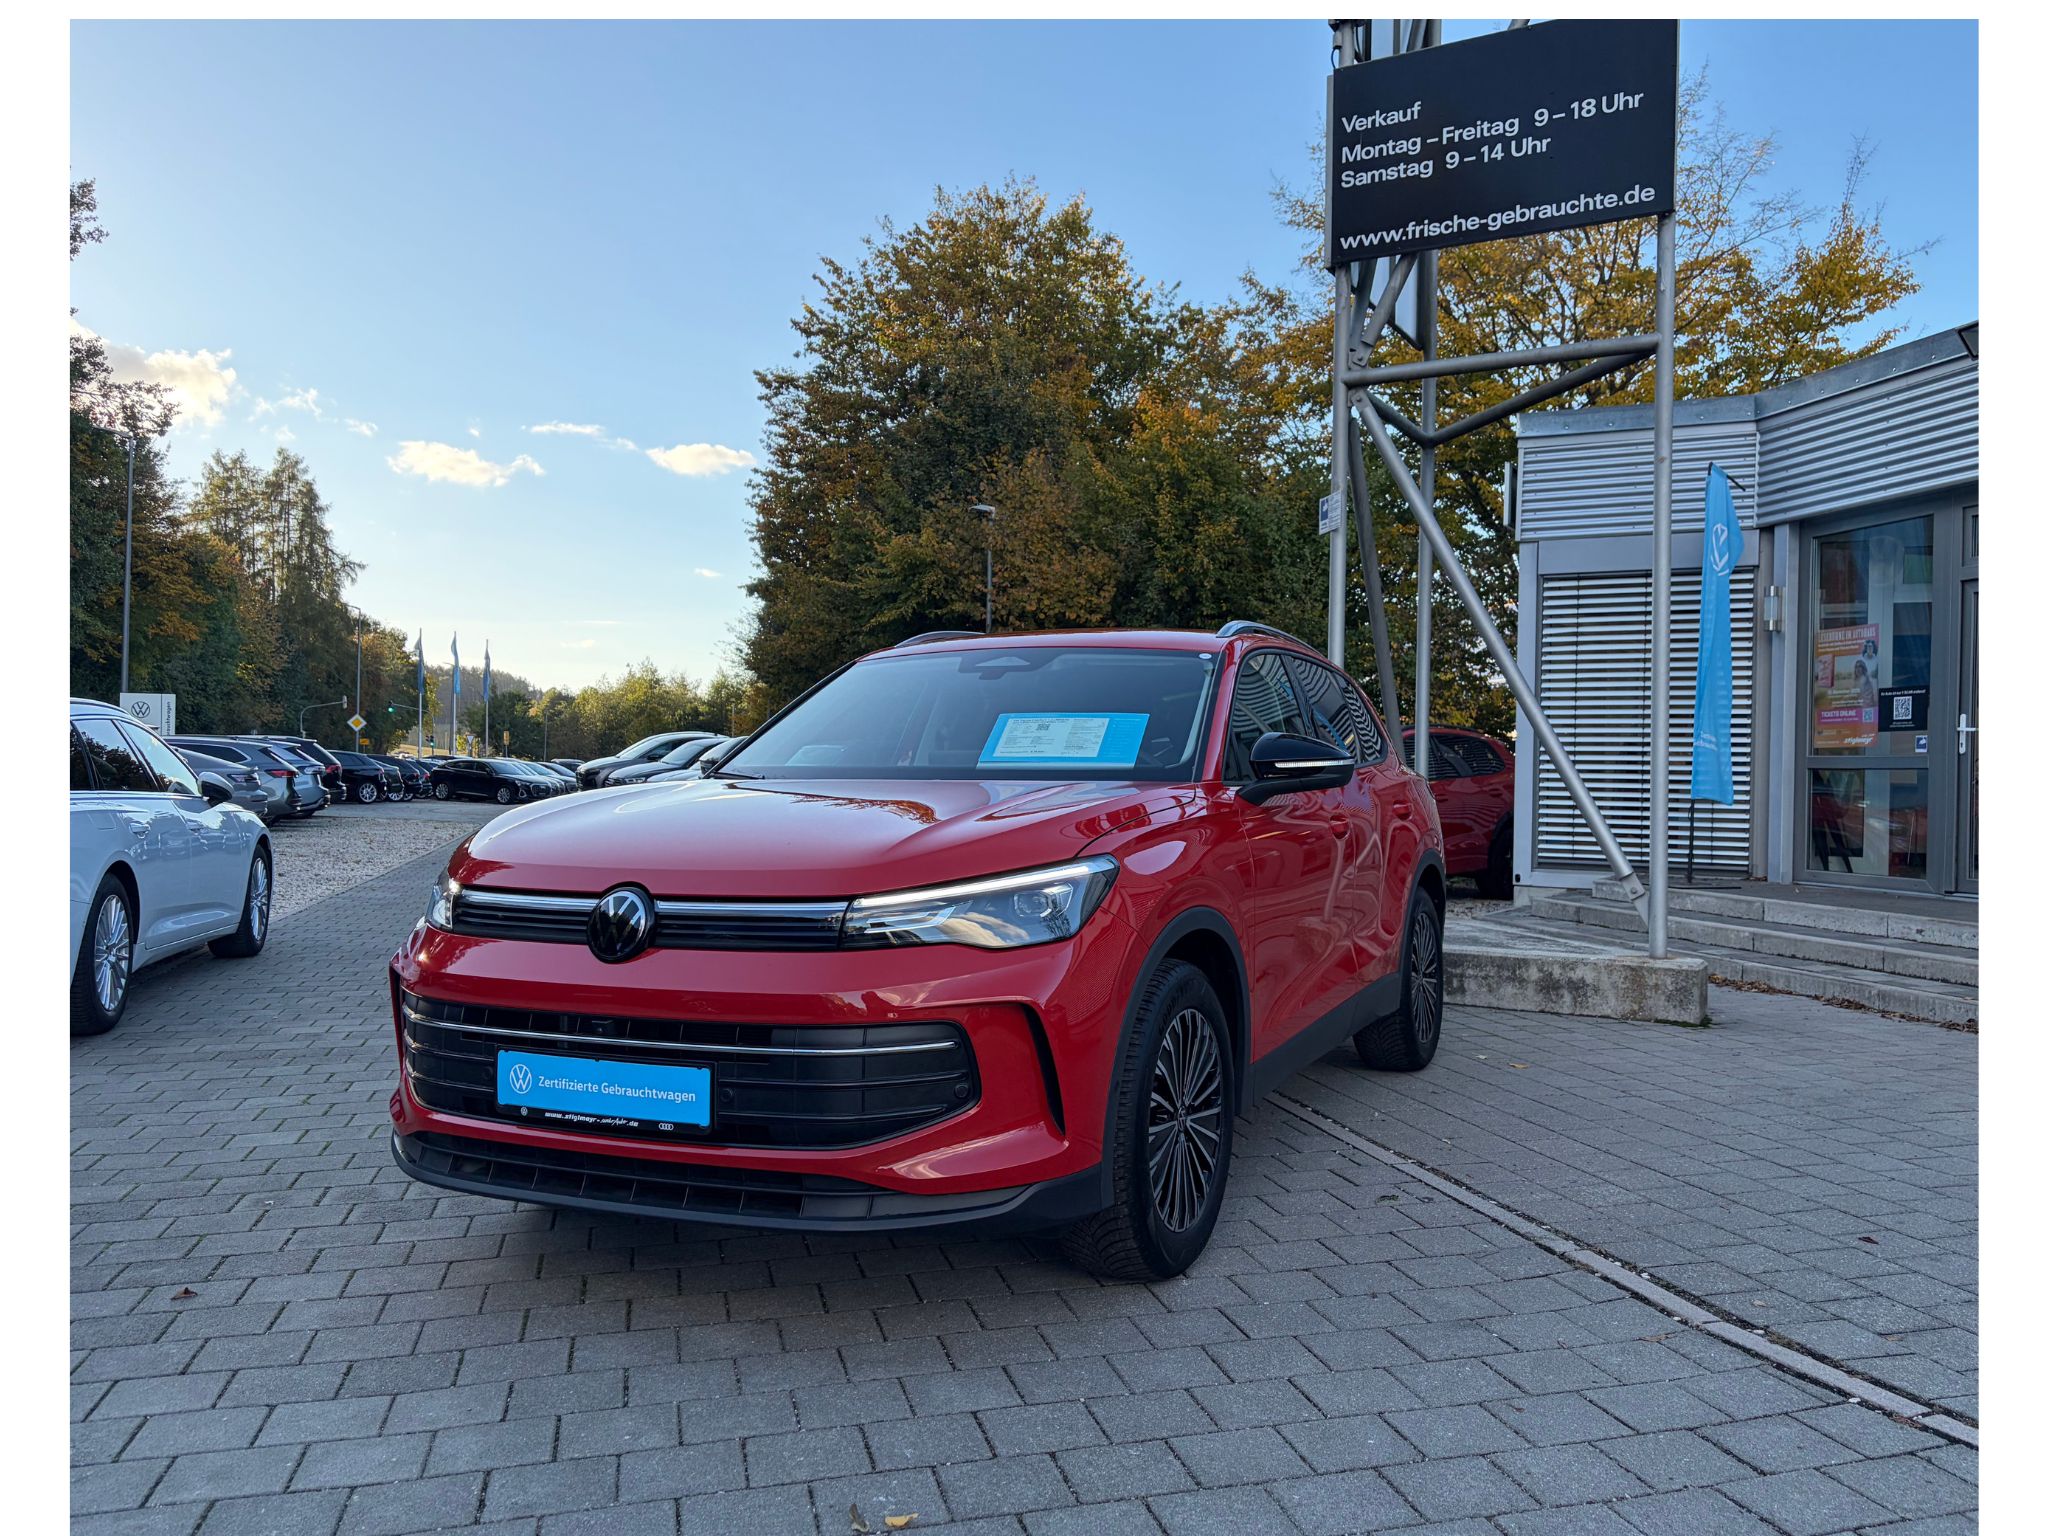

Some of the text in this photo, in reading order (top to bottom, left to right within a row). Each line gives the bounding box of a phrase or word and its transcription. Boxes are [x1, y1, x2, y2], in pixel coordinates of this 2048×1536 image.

[1341, 101, 1422, 133] Verkauf
[1341, 137, 1422, 164] Montag
[1442, 117, 1520, 145] Freitag
[1601, 91, 1644, 114] Uhr
[1340, 159, 1434, 188] Samstag
[1511, 136, 1552, 157] Uhr
[1339, 184, 1656, 250] www.frische-gebrauchte.de
[538, 1075, 696, 1104] Zertifizierte Gebrauchtwagen
